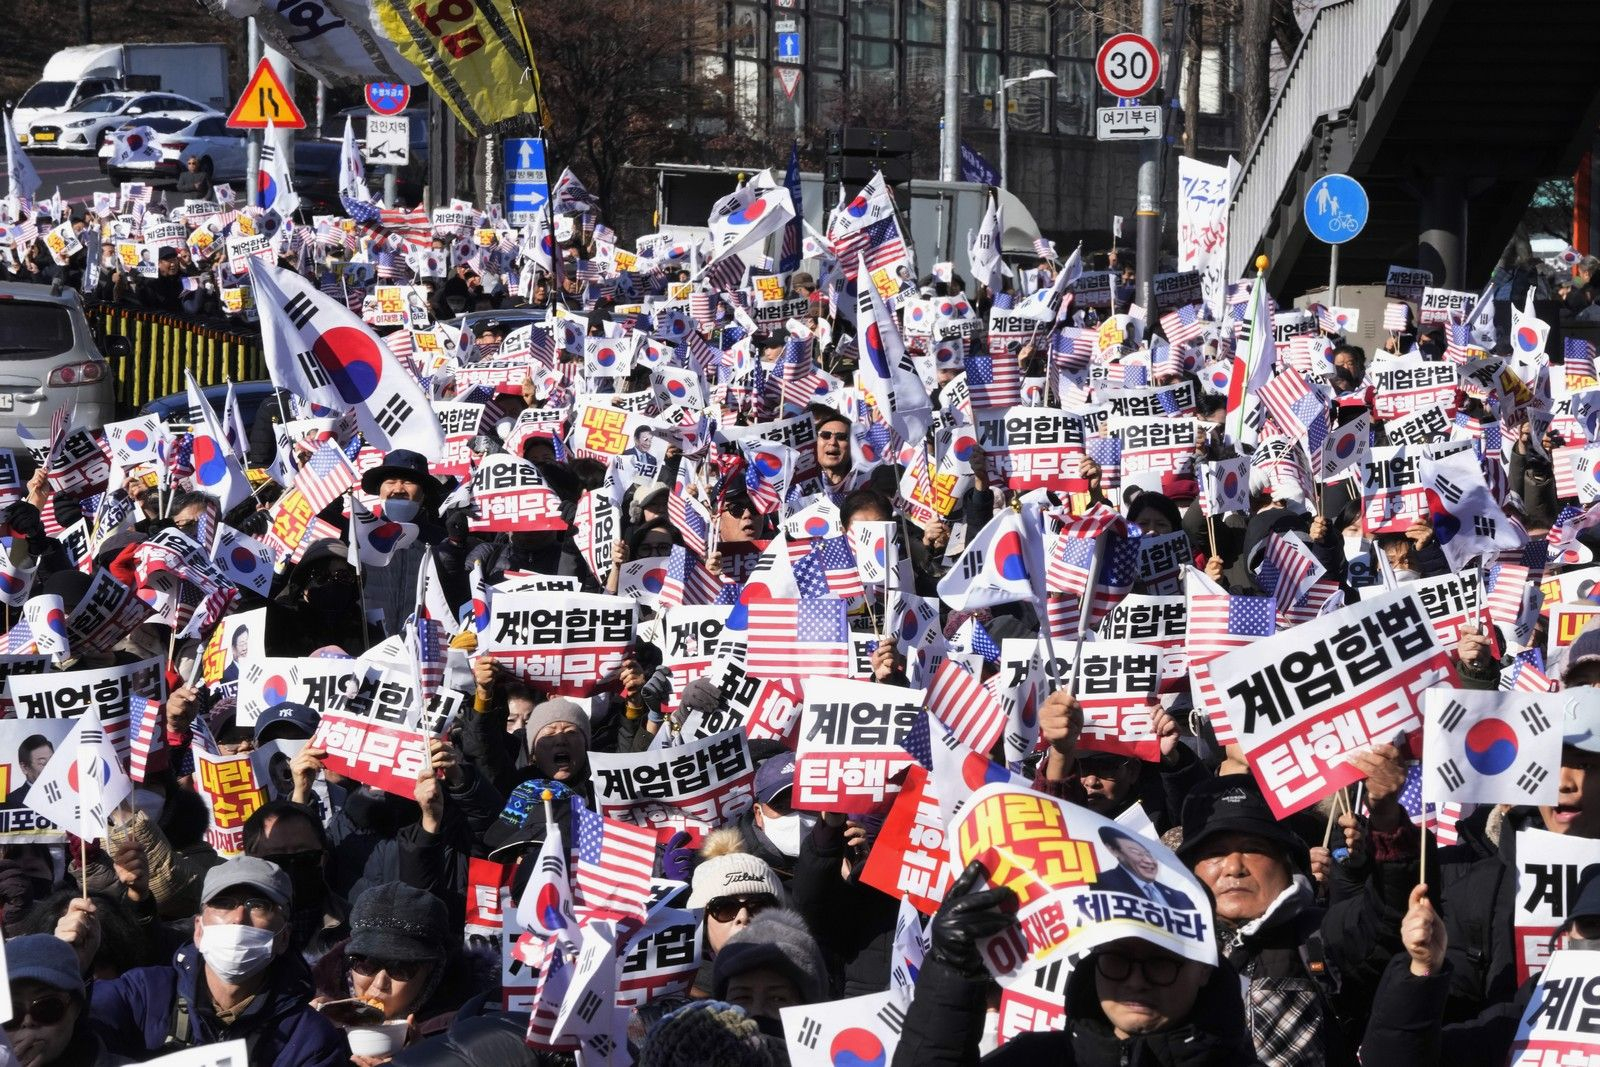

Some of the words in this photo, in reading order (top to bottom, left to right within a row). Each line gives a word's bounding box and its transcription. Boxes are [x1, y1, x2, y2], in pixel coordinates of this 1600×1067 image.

[1110, 52, 1147, 79] 30
[370, 120, 407, 134] 견인지역
[1103, 110, 1157, 125] 여기부터
[485, 140, 494, 191] Neighborhood
[508, 171, 544, 179] 일방통행
[509, 213, 535, 222] 일방통
[754, 299, 809, 321] 계엄합법
[1375, 365, 1455, 391] 계엄합법
[438, 408, 480, 434] 엄합법
[581, 406, 628, 434] 내란
[979, 415, 1083, 448] 계엄합법
[585, 430, 630, 455] 수괴
[473, 463, 544, 491] 계엄합
[985, 450, 1084, 482] 탄핵무효
[1365, 458, 1421, 489] 계엄
[1366, 494, 1428, 529] 탄핵
[495, 607, 634, 646] 계엄합법
[1226, 595, 1436, 735] 계엄합법
[1083, 705, 1158, 743] 무효
[200, 757, 252, 793] 내란
[598, 733, 746, 803] 계엄합법
[897, 775, 951, 903] 탄핵
[960, 793, 1063, 857] 내란
[990, 838, 1099, 903] 수괴
[985, 899, 1071, 978] 이재명
[1073, 890, 1208, 943] 체포하라
[1527, 976, 1600, 1034] 계엄
